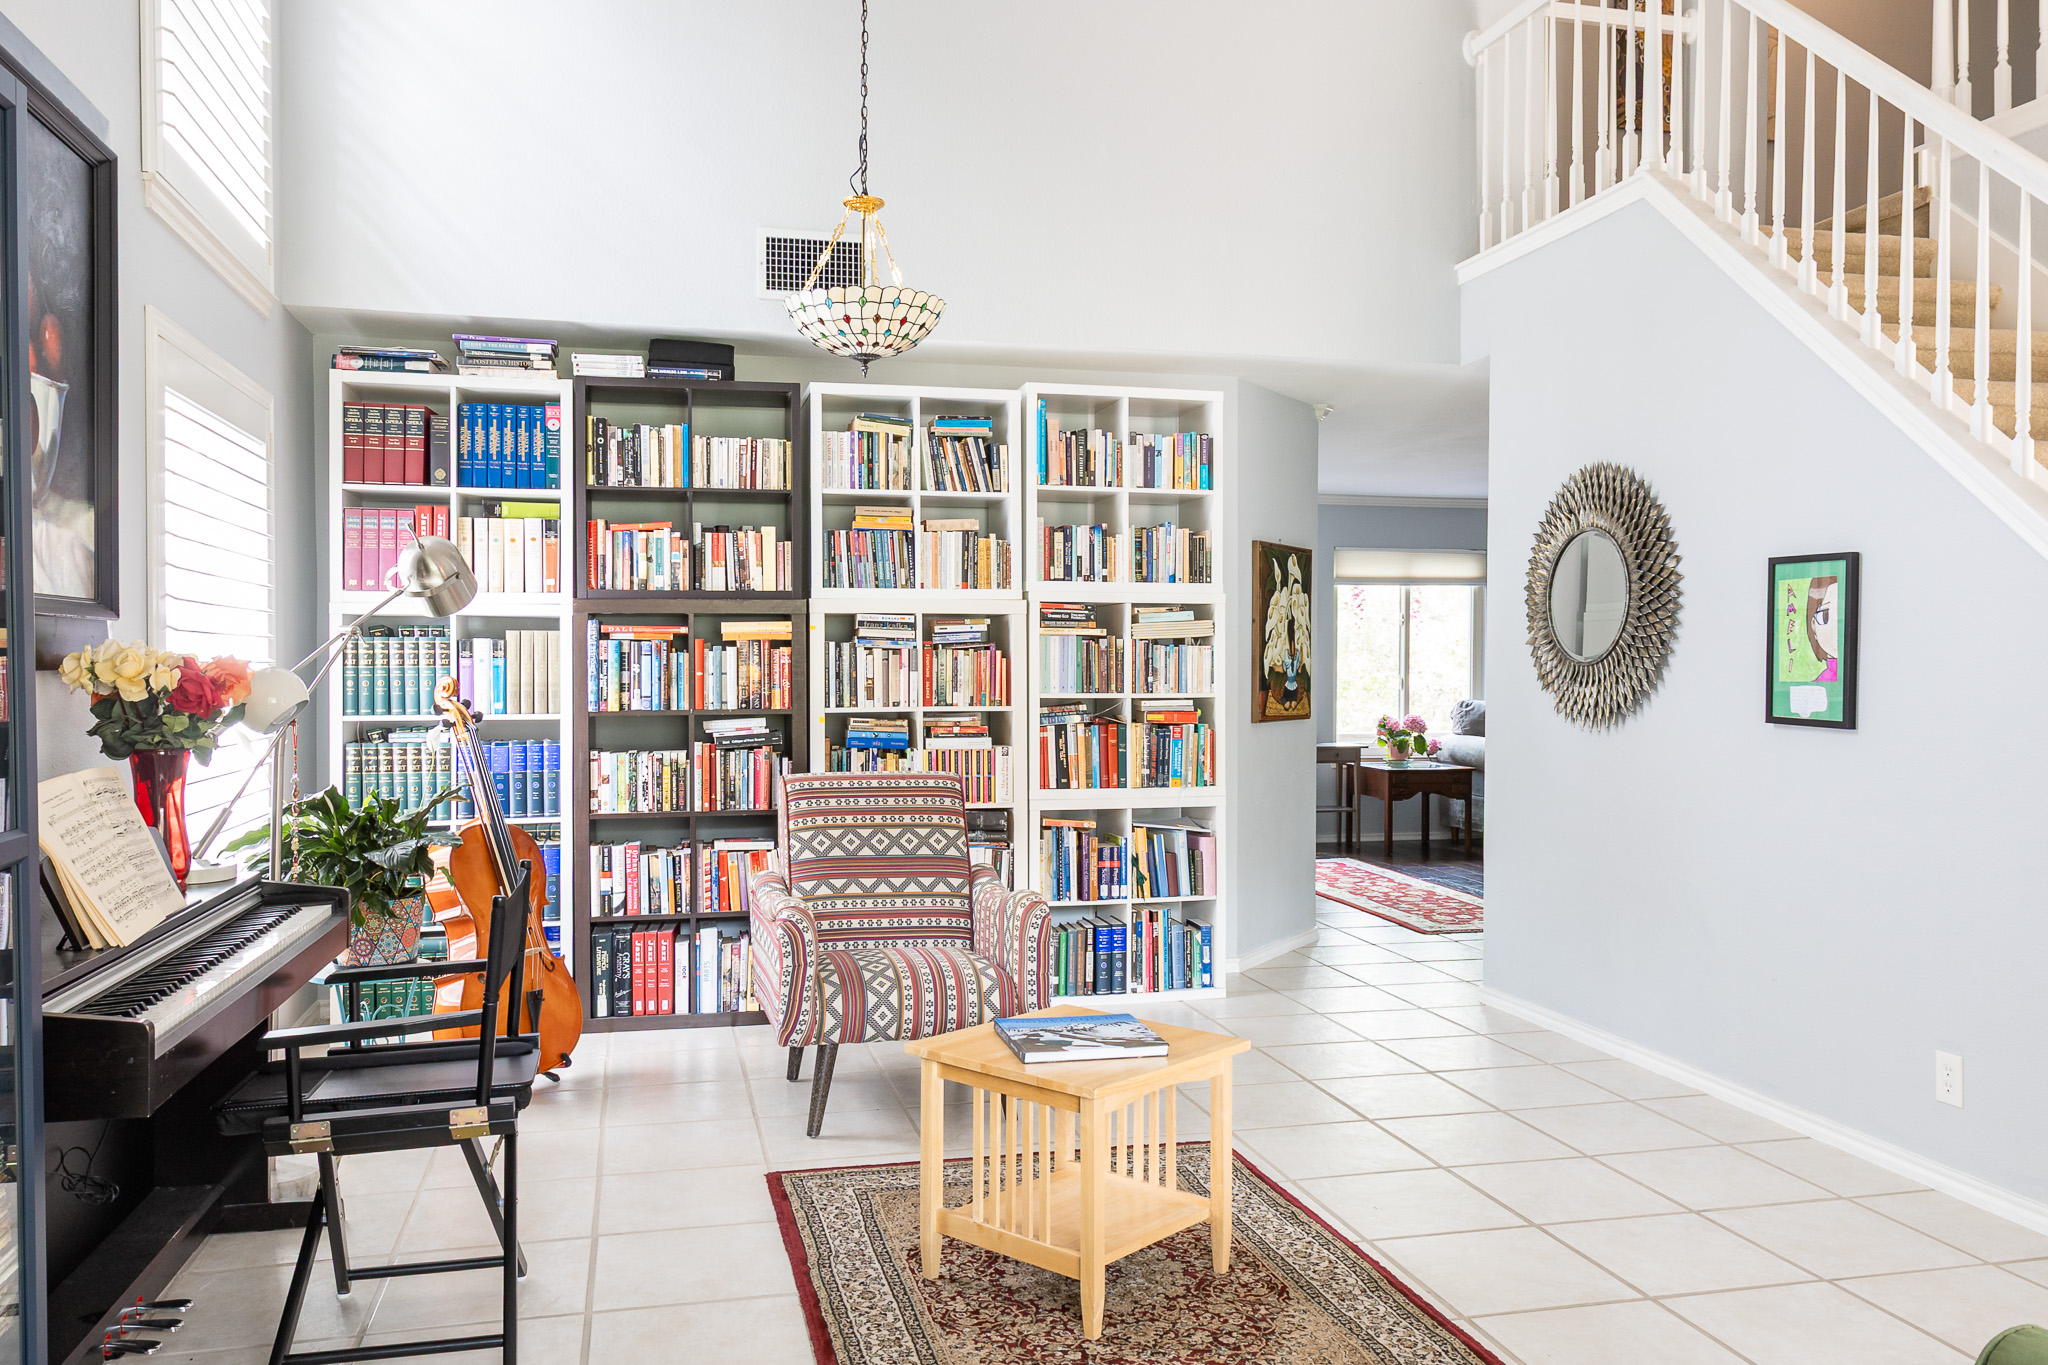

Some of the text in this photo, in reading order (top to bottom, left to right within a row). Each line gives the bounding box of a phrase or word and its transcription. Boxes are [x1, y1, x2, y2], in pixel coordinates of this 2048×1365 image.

[864, 621, 909, 629] franz kafka
[1786, 584, 1797, 673] AMELI
[614, 952, 623, 979] Anatomy
[622, 952, 631, 979] GRAY'S
